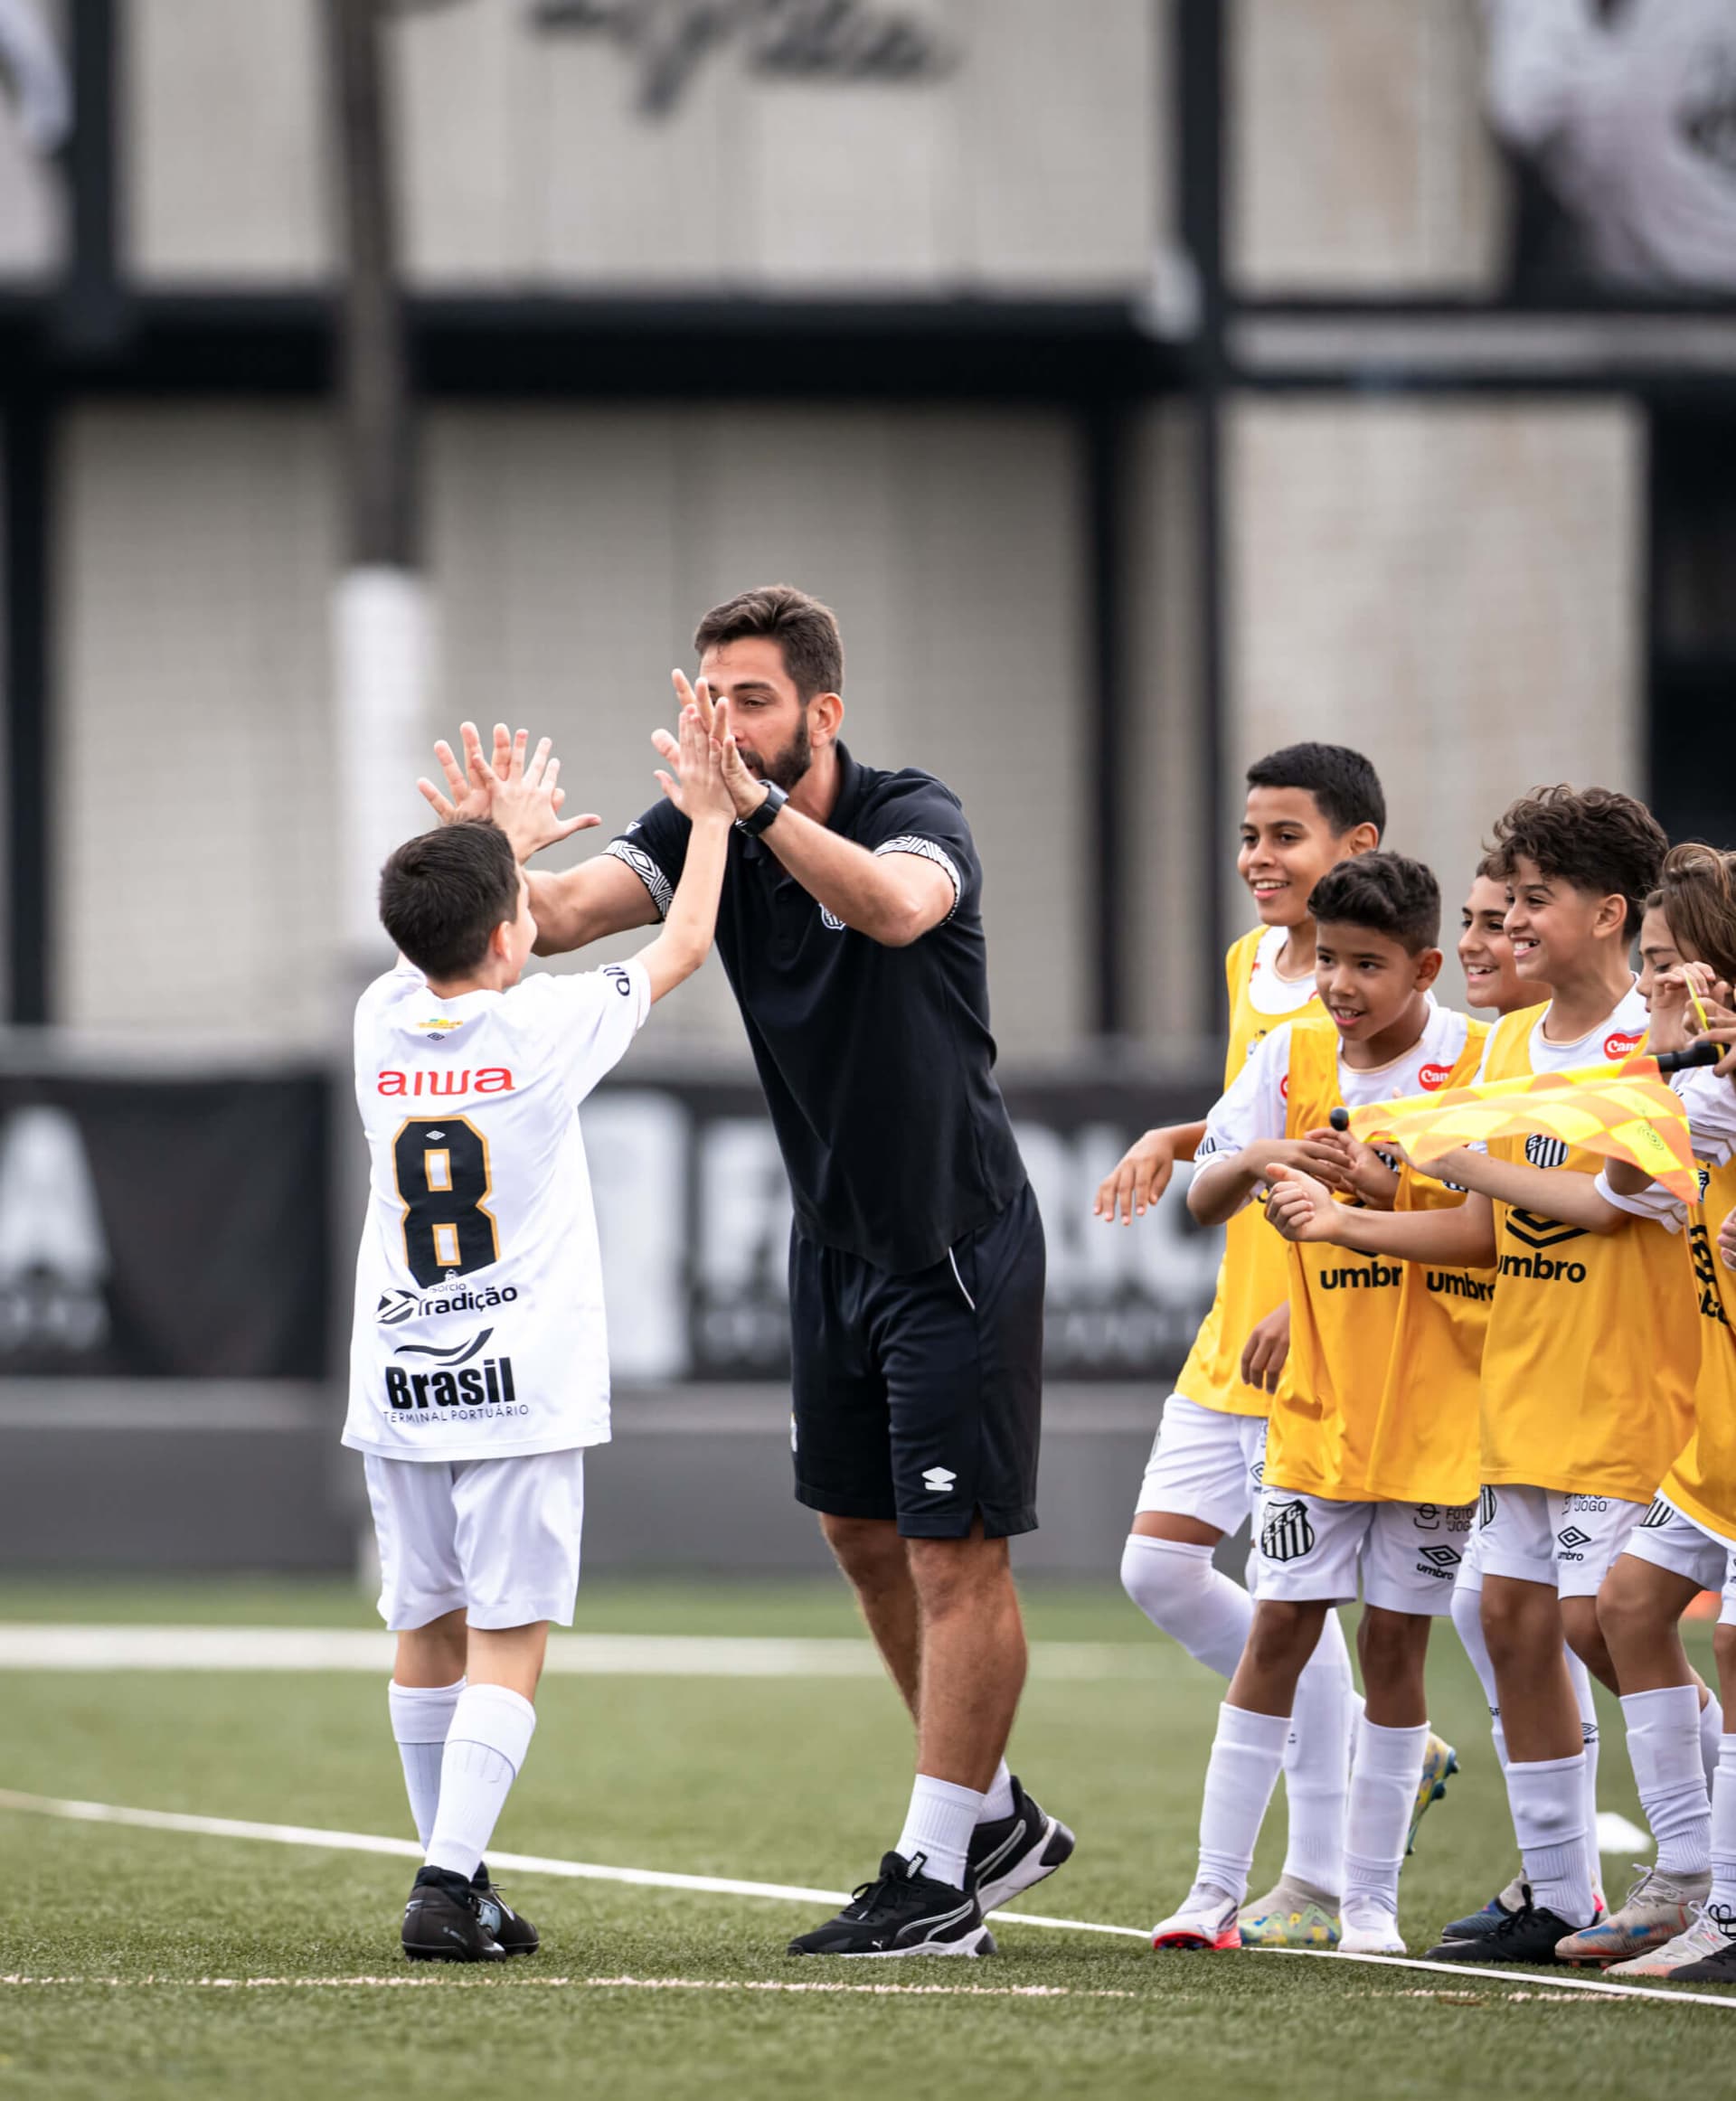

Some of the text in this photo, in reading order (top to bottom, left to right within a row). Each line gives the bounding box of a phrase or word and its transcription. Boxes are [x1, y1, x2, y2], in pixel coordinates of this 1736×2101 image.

[378, 1068, 515, 1096] aiwa
[392, 1115, 501, 1289] 8
[1320, 1261, 1403, 1289] umbr
[385, 1357, 516, 1410] Brasil
[383, 1403, 529, 1424] TERMINAL PORTUÁRIO
[1417, 1562, 1454, 1580] umbro
